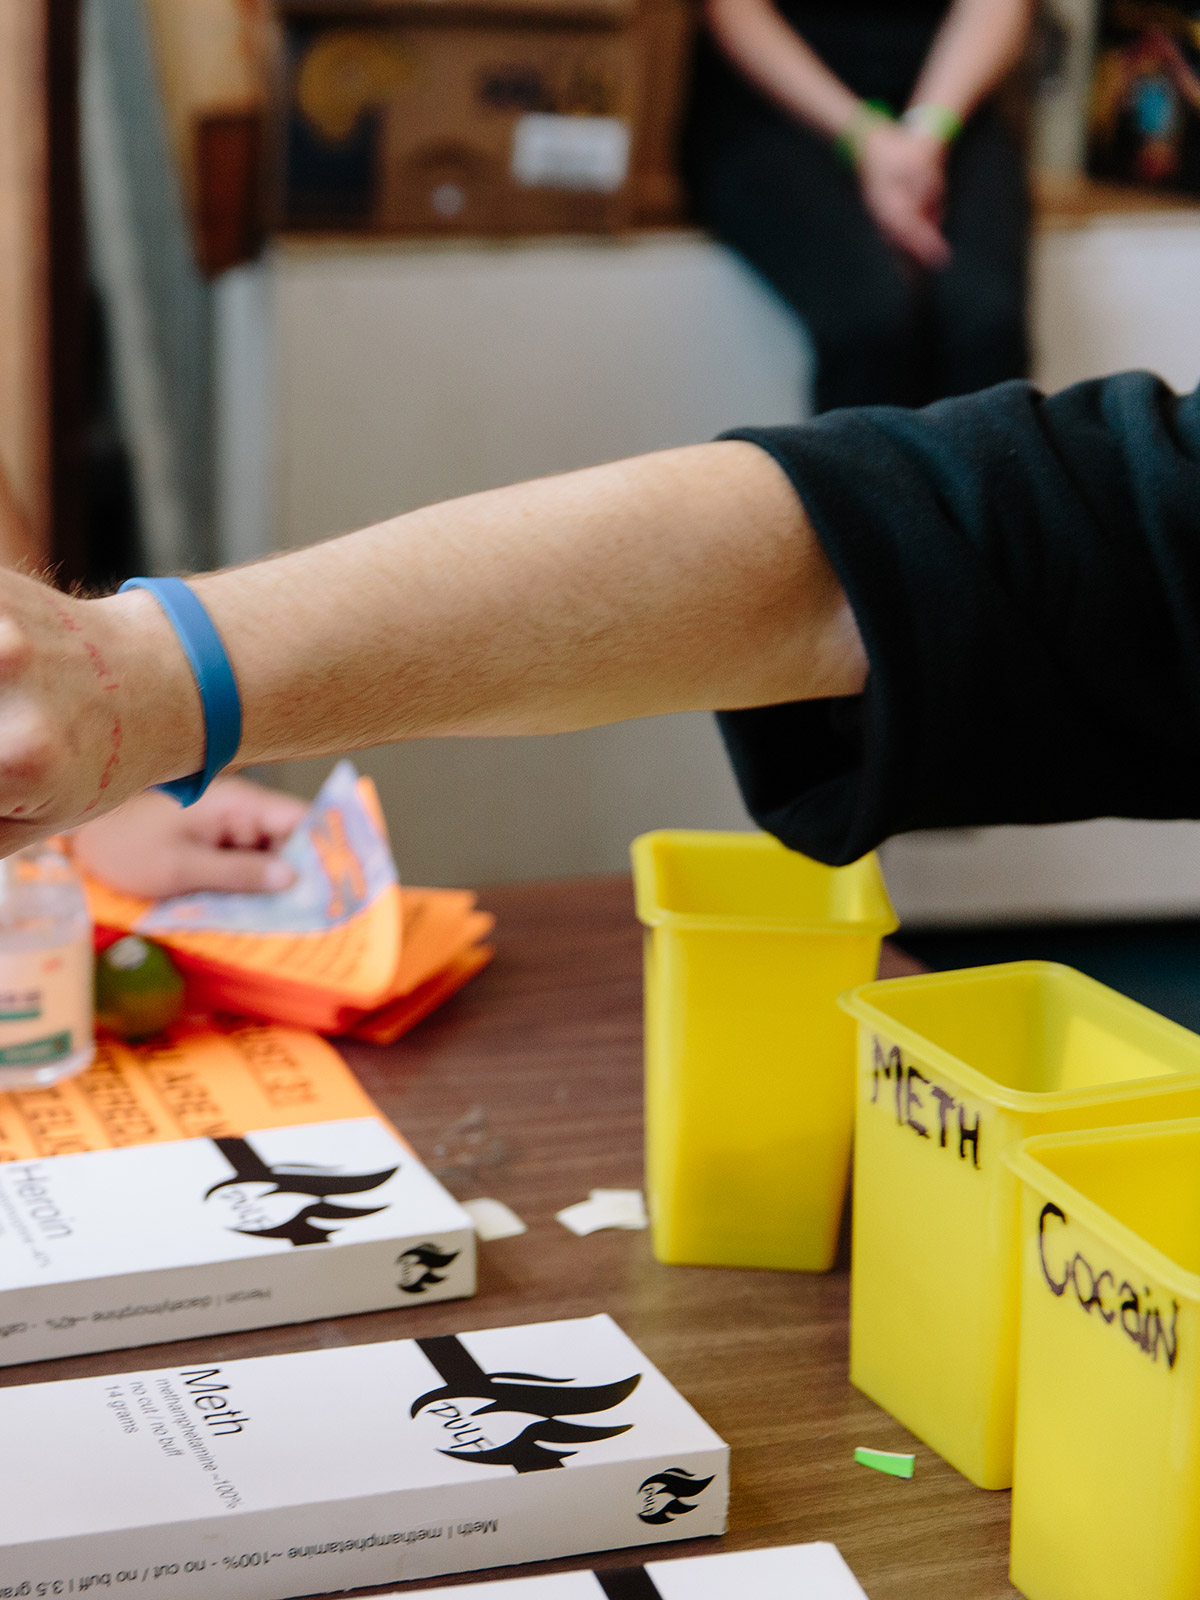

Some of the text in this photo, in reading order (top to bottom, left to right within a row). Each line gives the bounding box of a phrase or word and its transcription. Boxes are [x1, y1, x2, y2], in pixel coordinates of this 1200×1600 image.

[870, 1034, 981, 1170] METH
[7, 1163, 75, 1240] Heroin
[128, 1380, 147, 1396] no
[104, 1385, 140, 1435] 14 grams
[137, 1396, 160, 1414] cut
[179, 1368, 251, 1436] Meth
[150, 1421, 168, 1436] no
[155, 1378, 218, 1472] methamphetamine
[158, 1436, 186, 1457] buff
[456, 1519, 499, 1537] Meth
[287, 1527, 443, 1560] methamphetamine
[153, 1563, 180, 1580] cut
[183, 1559, 207, 1573] no
[79, 1572, 112, 1591] buff
[116, 1568, 138, 1583] no
[36, 1579, 64, 1597] 3.5
